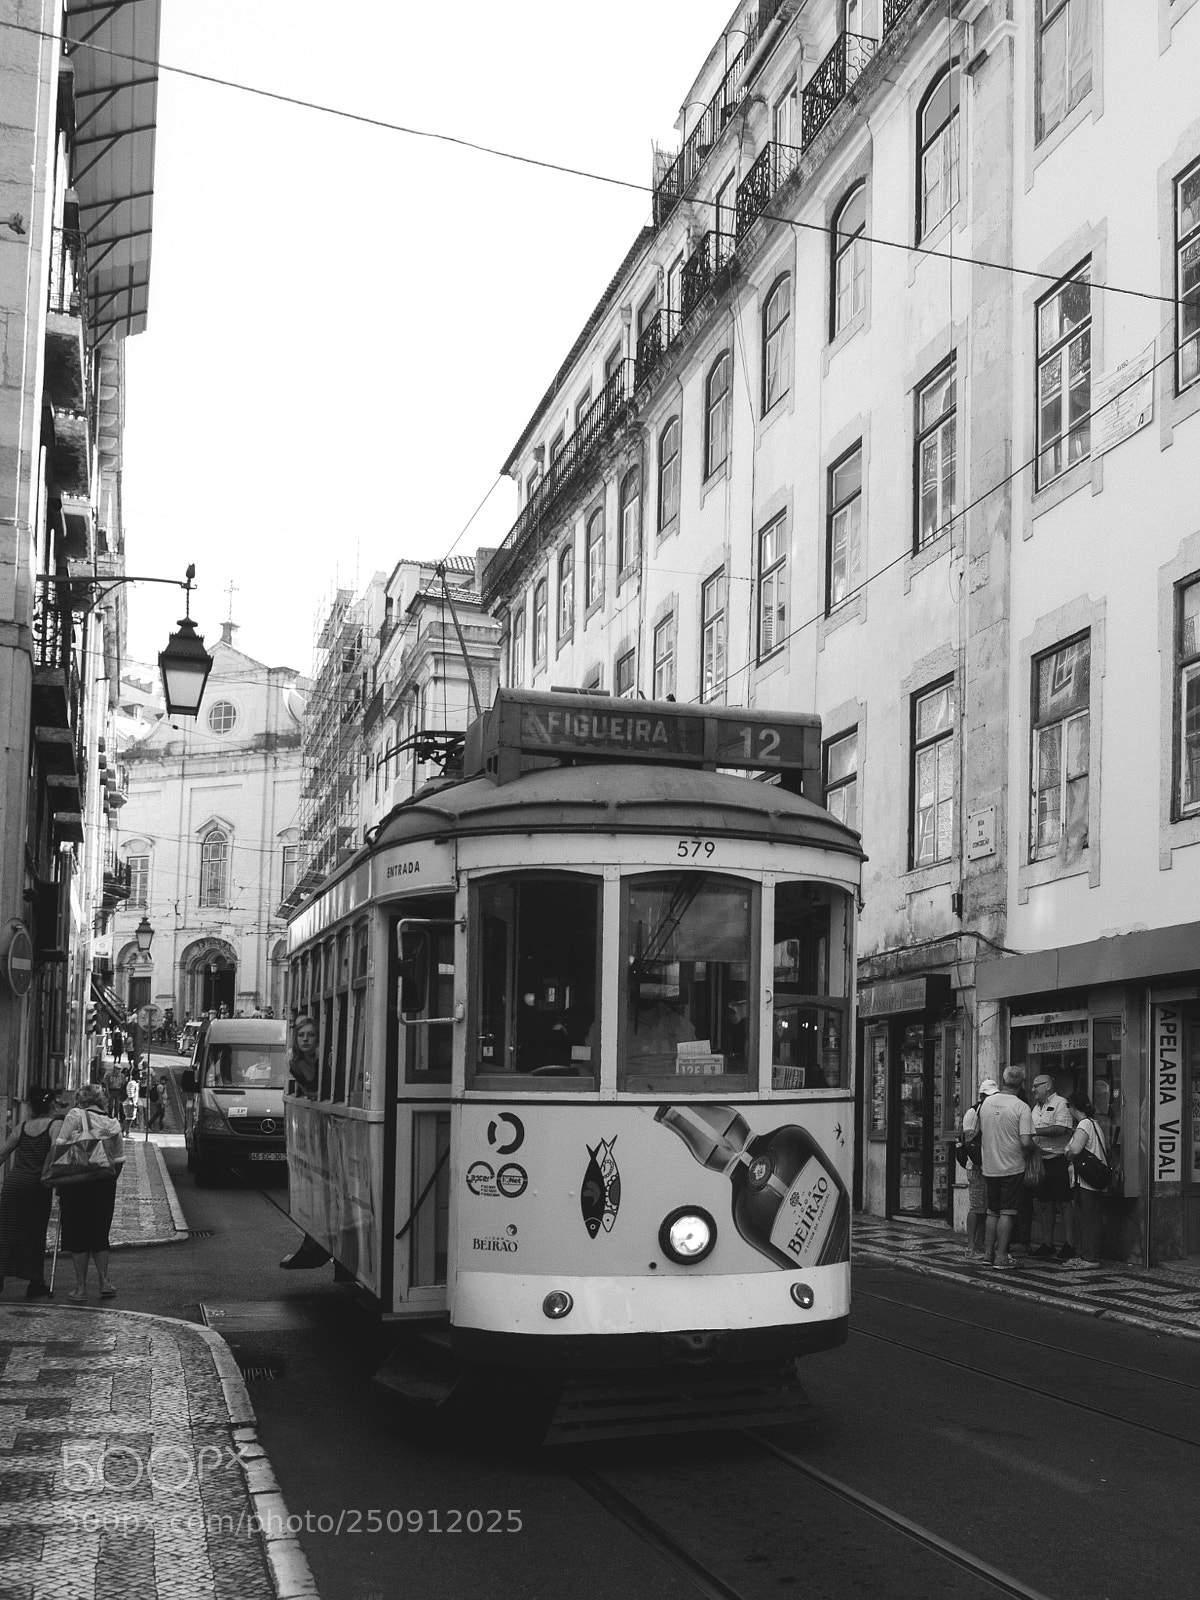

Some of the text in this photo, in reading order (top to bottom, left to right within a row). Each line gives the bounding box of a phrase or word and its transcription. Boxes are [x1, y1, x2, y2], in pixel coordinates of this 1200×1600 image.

[548, 711, 668, 743] FIGUEIRA
[739, 726, 781, 761] 12
[676, 840, 716, 858] 579
[387, 860, 420, 879] ENTRADA
[1158, 1119, 1180, 1180] VIDAL
[788, 1177, 827, 1256] BEIRÃO
[473, 1238, 517, 1252] BEIRÃO
